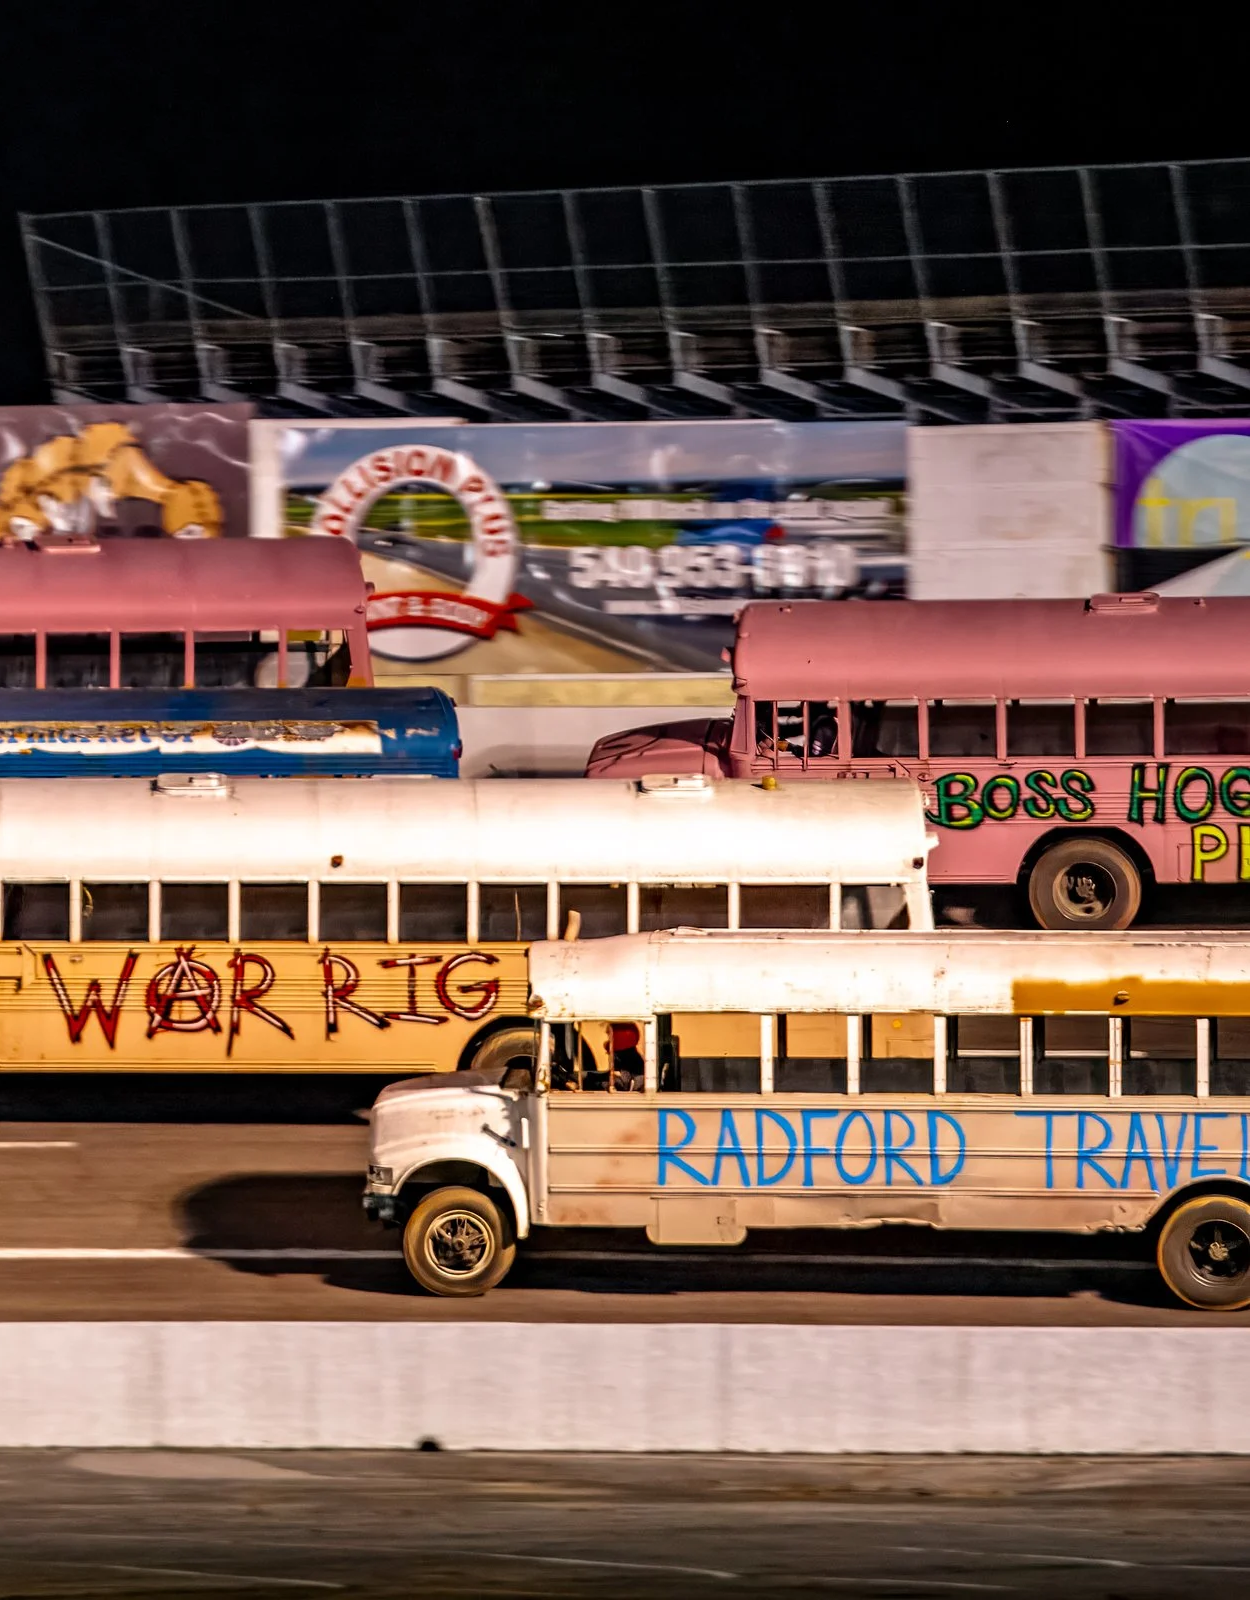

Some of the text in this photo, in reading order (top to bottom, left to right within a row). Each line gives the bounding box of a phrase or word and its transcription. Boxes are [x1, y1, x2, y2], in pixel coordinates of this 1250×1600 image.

[320, 449, 458, 537] OLLISION
[924, 769, 1095, 831] BOSS
[43, 945, 501, 1057] WAR RIG
[656, 1108, 967, 1187] RADFORD
